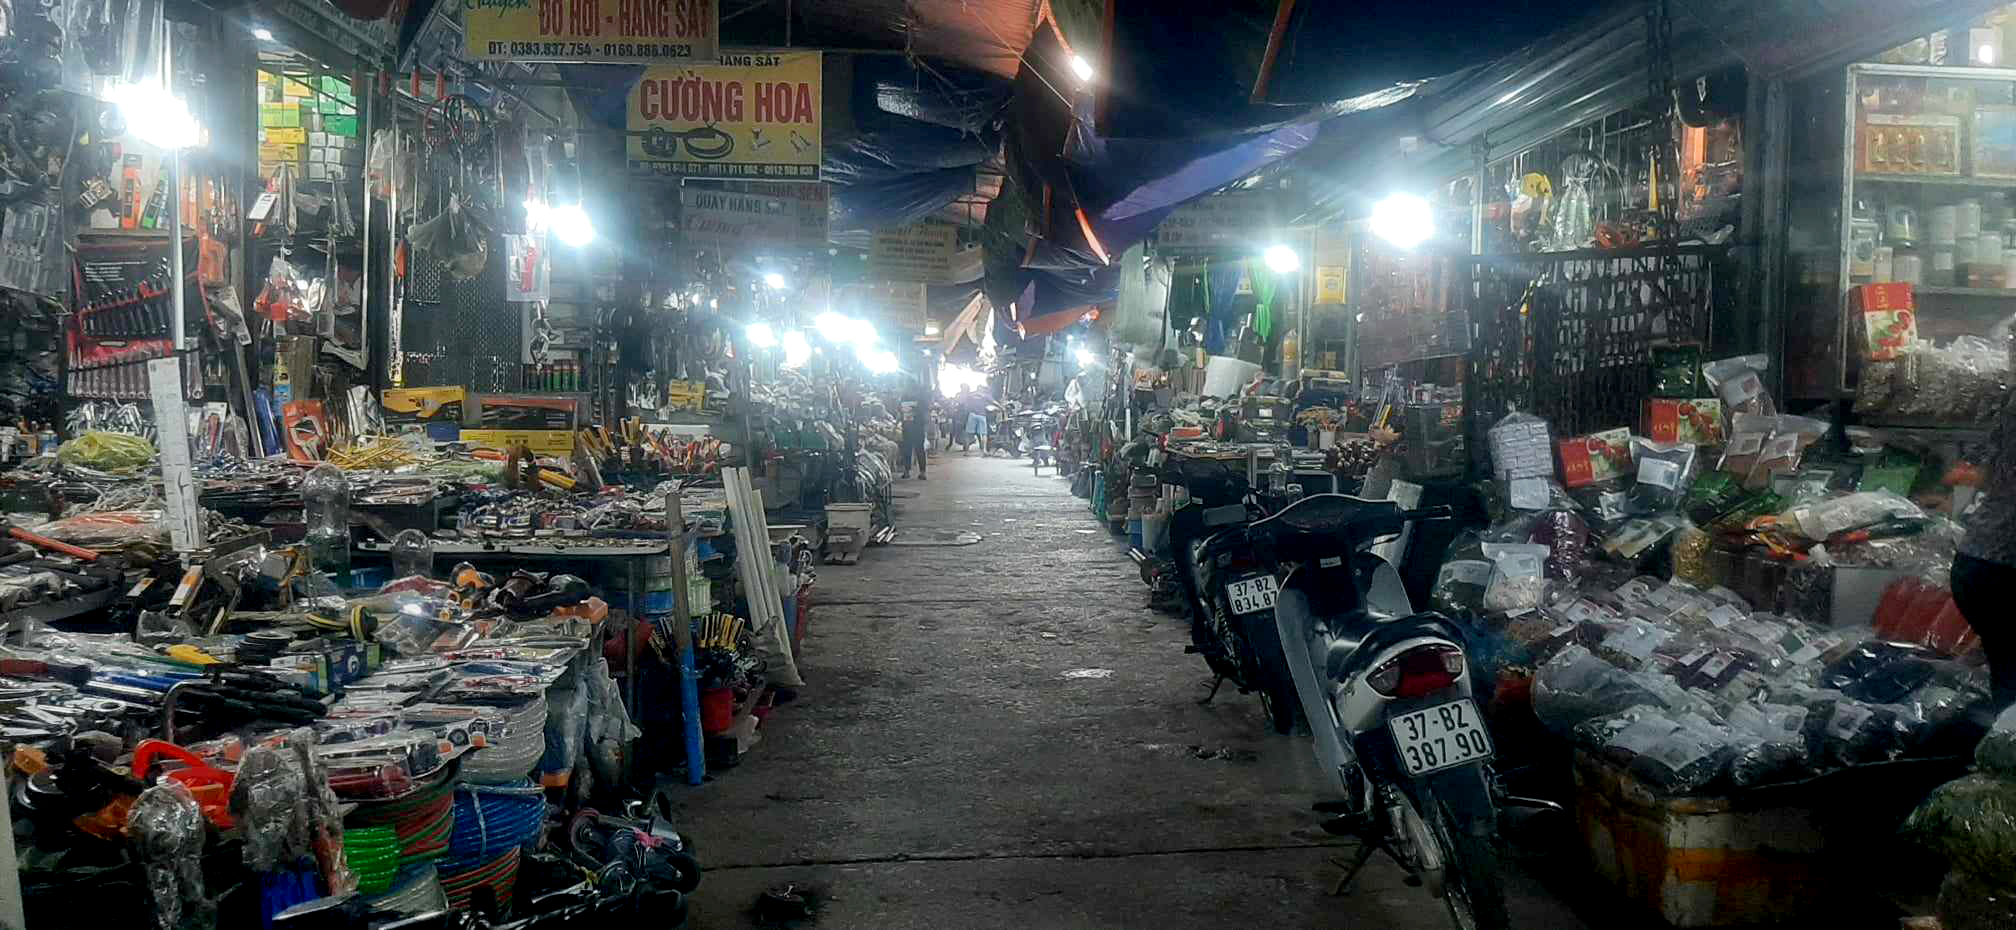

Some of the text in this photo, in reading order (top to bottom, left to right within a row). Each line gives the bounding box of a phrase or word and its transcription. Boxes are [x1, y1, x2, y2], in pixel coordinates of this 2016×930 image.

[639, 70, 814, 124] CƯỜNG HOA
[1233, 577, 1272, 597] 37-B2
[1234, 590, 1278, 613] 834.87
[1402, 703, 1469, 741] 37-B2
[1406, 728, 1487, 771] 387.90
